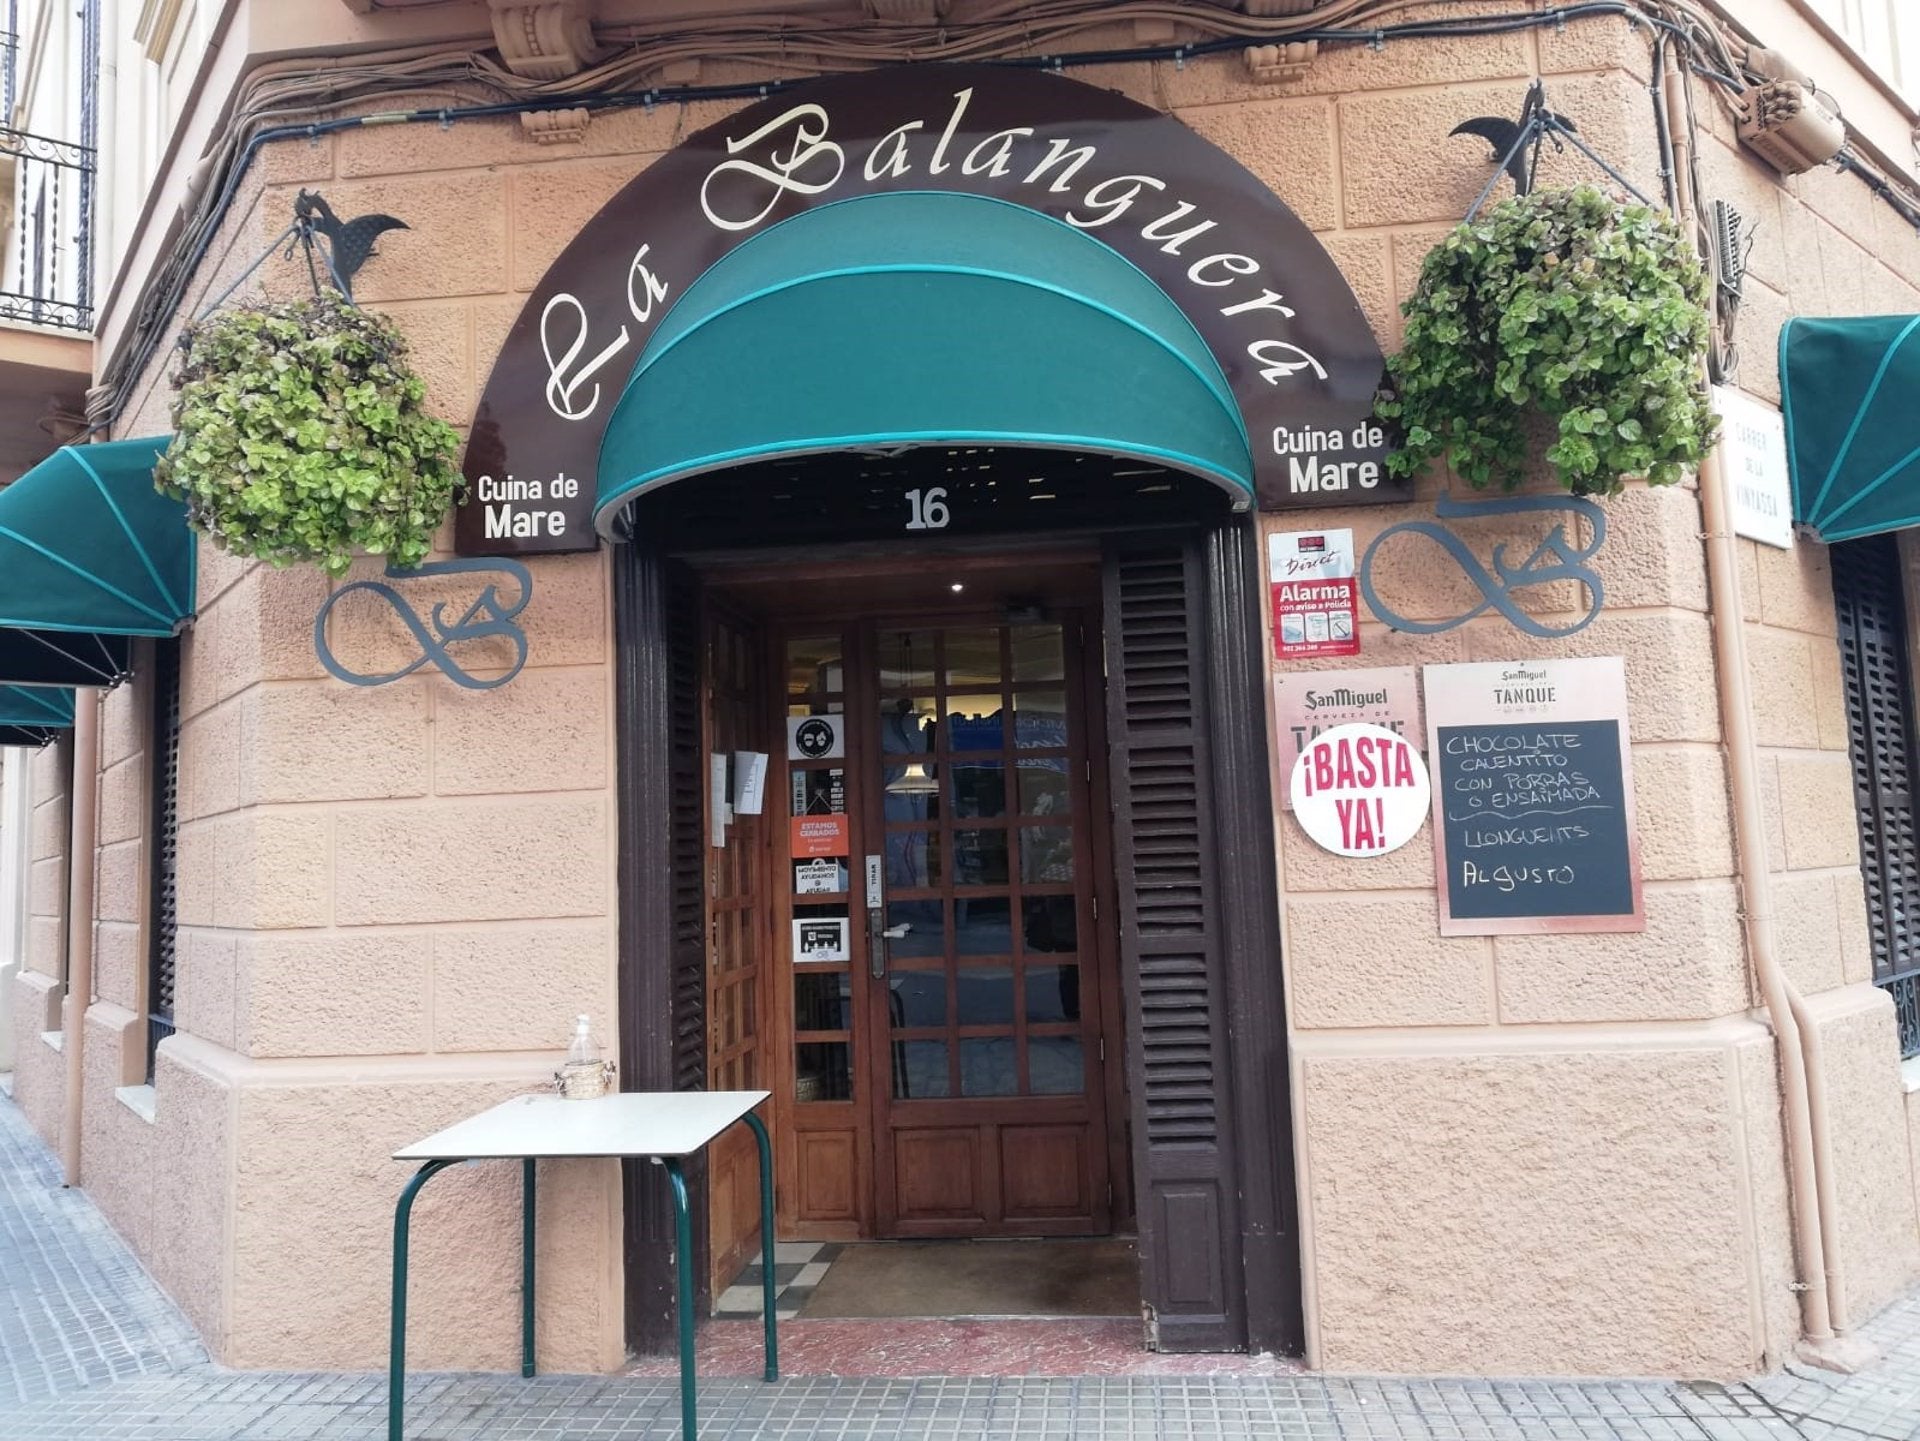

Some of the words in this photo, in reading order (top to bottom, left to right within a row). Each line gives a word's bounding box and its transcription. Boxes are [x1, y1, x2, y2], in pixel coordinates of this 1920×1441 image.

[540, 243, 668, 420] La
[701, 87, 1328, 386] Balanguera
[1273, 425, 1343, 454] Cuina
[1352, 421, 1383, 447] de
[1736, 422, 1767, 451] CARRER
[1289, 455, 1379, 493] Mare
[478, 475, 542, 502] Cuina
[550, 473, 578, 499] de
[904, 487, 950, 530] 16
[484, 503, 566, 539] Mare
[1279, 584, 1351, 603] Alarma
[1295, 602, 1317, 611] aviso
[1501, 669, 1547, 681] SanMiguel
[1304, 688, 1388, 711] SanMiguel
[1493, 687, 1556, 704] TANQUE
[1304, 712, 1364, 720] CERVEZA
[1446, 734, 1582, 754] CHOCOLATE
[1303, 736, 1416, 797] ¡BASTA
[1454, 777, 1493, 791] CON
[1503, 772, 1590, 790] PORRAS
[800, 829, 840, 837] CERRADOS
[801, 822, 838, 830] ESTAMOS
[1335, 798, 1386, 850] YA!
